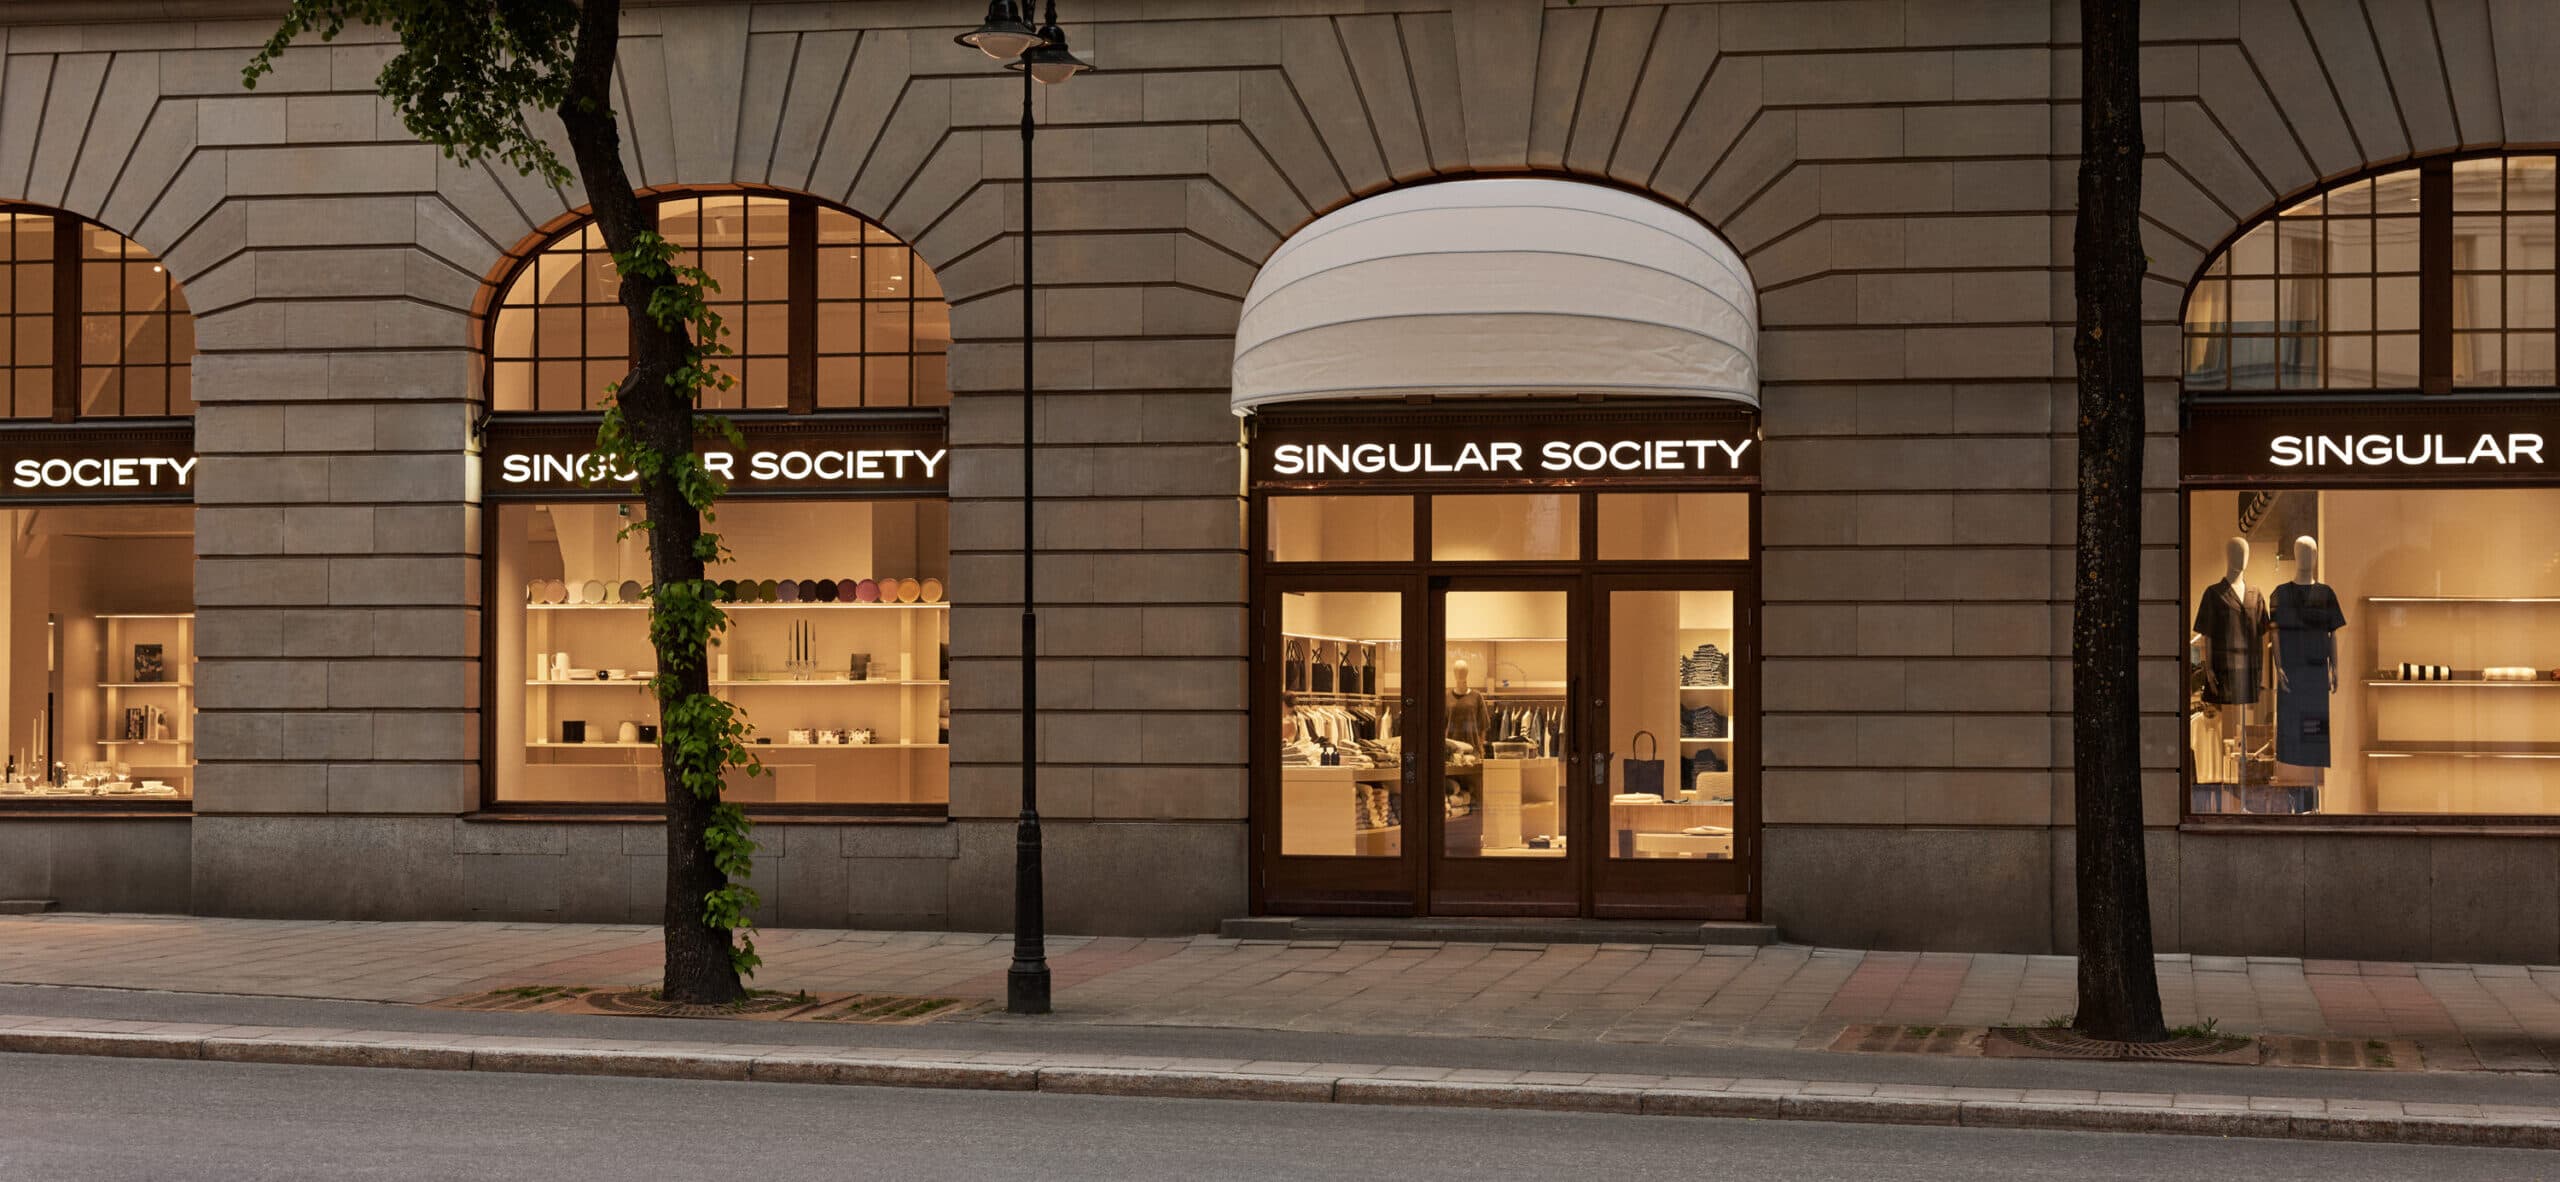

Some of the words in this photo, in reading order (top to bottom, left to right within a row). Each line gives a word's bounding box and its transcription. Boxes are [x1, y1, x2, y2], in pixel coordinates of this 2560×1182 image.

[750, 449, 947, 481] SOCIETY
[1273, 442, 1523, 475] SINGULAR
[1541, 438, 1753, 471] SOCIETY
[2269, 433, 2545, 467] SINGULAR
[13, 457, 198, 488] SOCIETY
